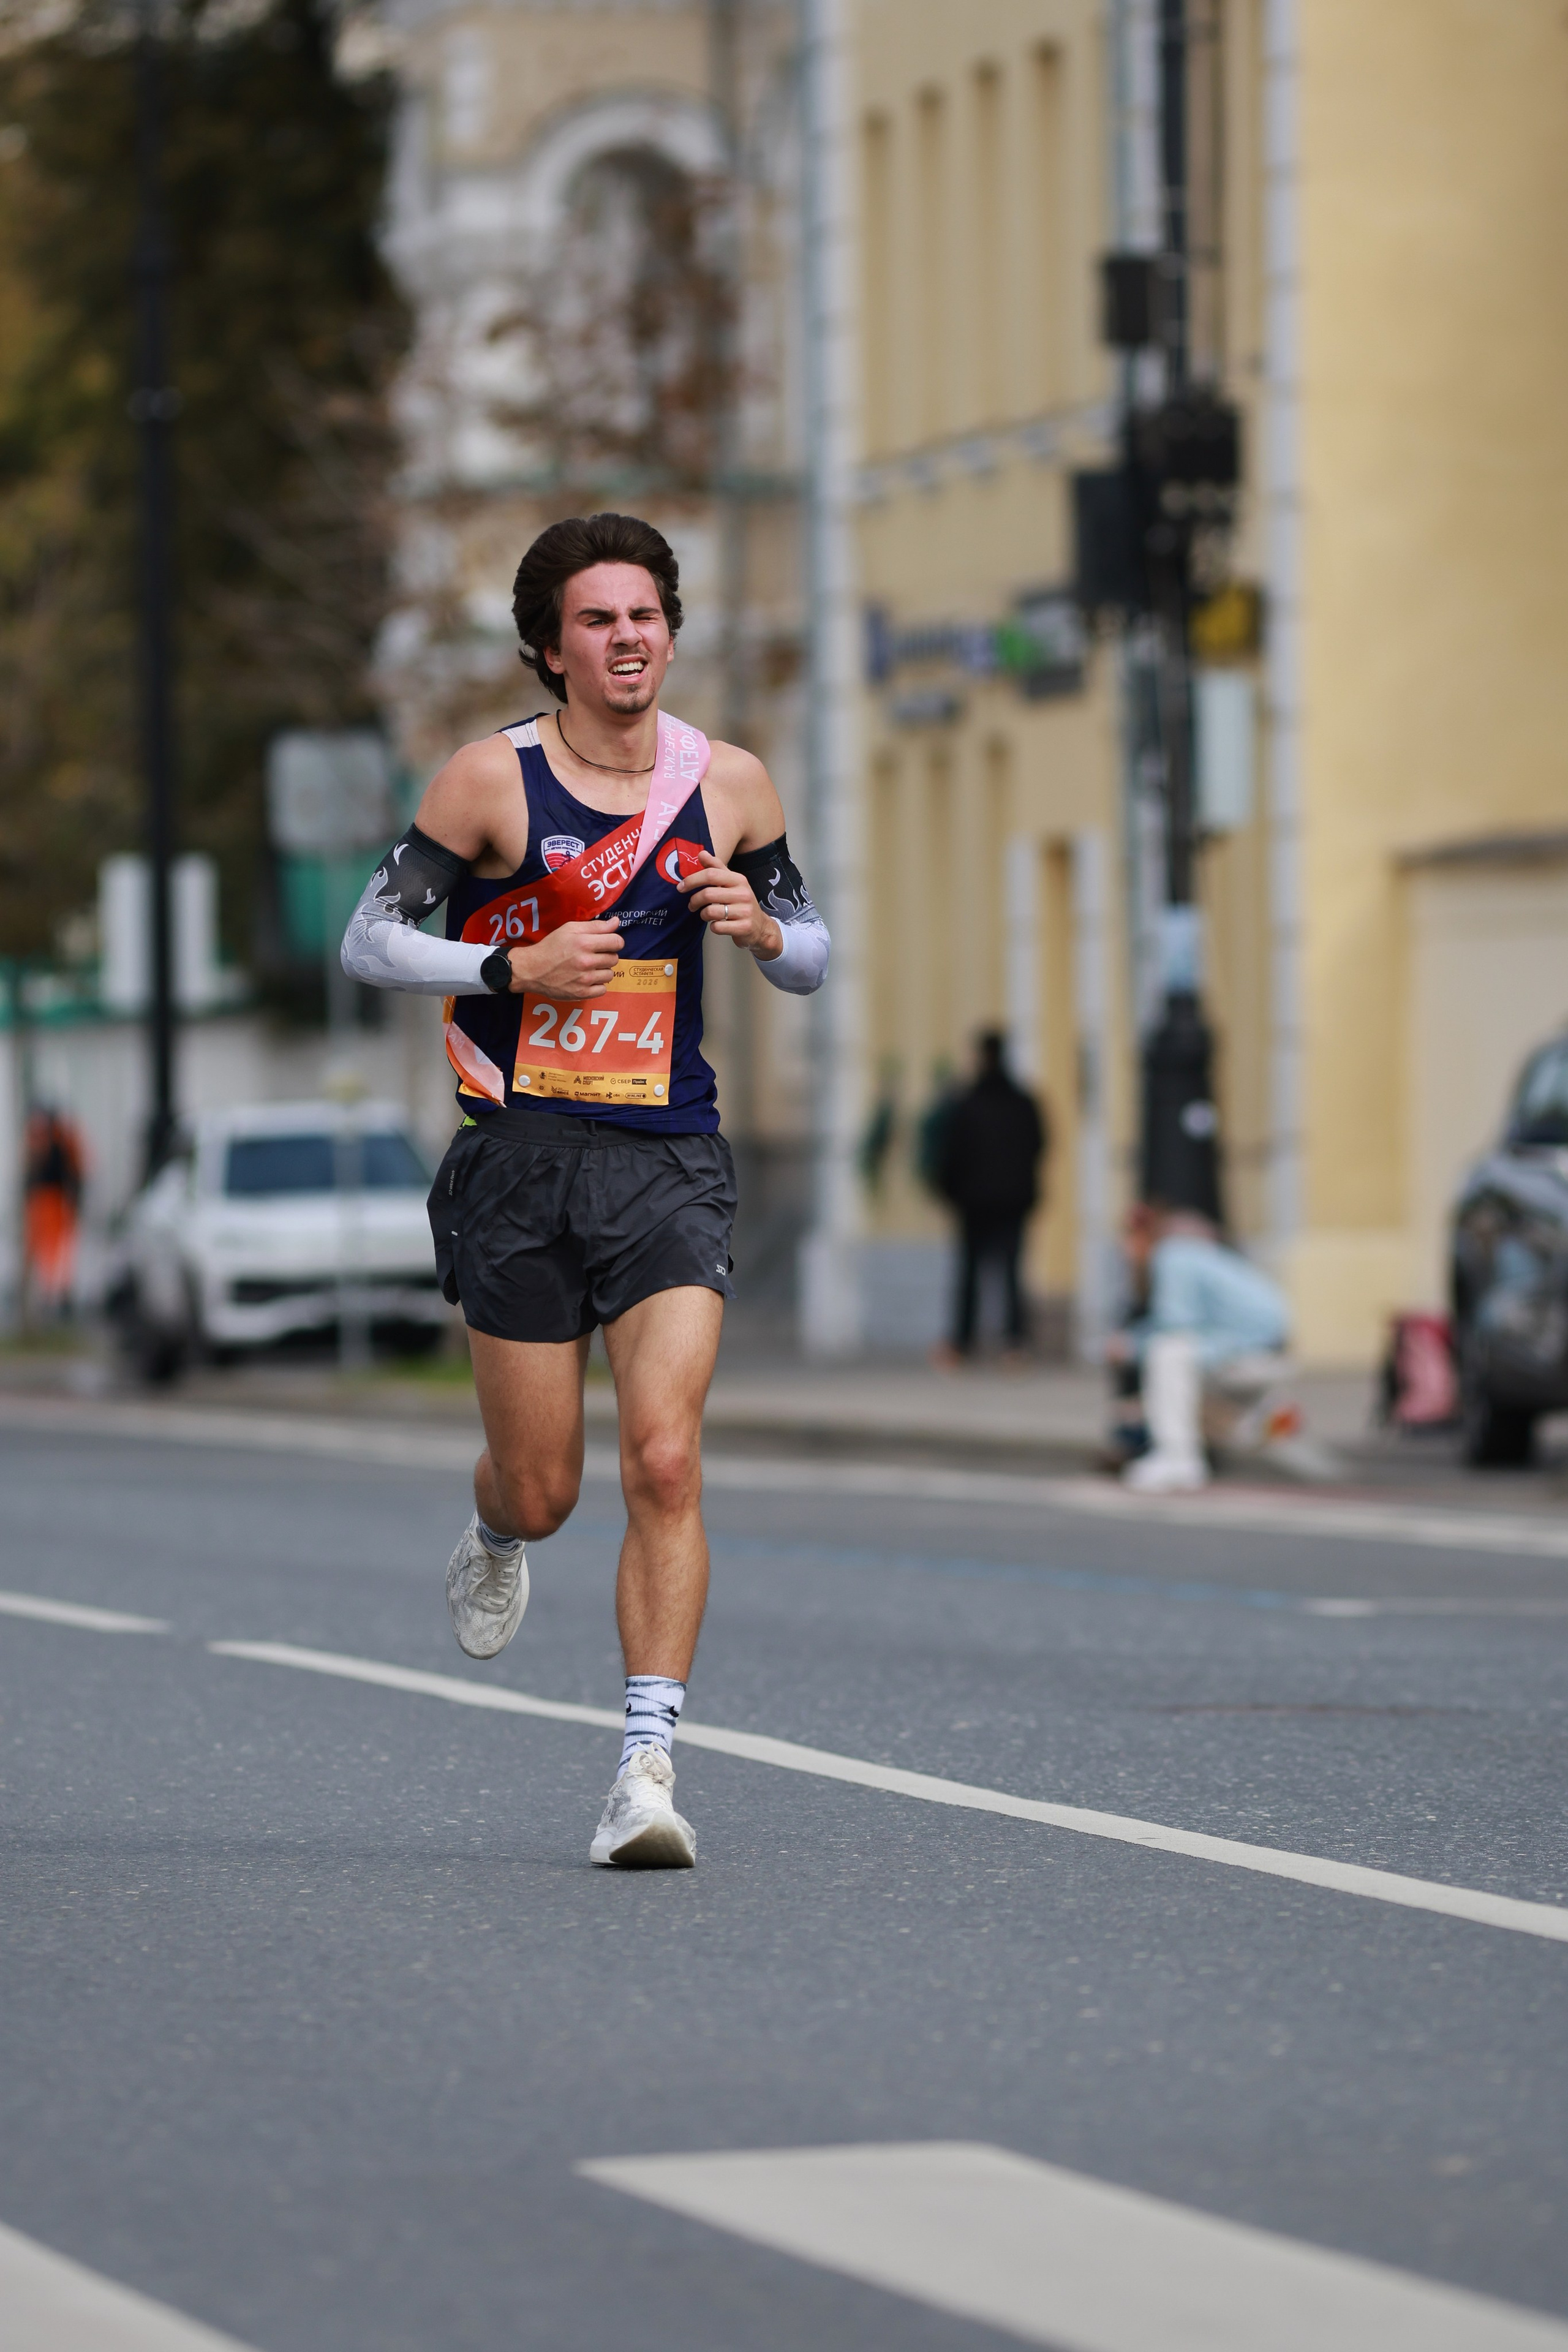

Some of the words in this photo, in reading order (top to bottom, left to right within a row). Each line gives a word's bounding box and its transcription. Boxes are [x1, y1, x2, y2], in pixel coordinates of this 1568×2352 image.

[547, 840, 579, 848] ЭВЕРЕСТ
[581, 826, 642, 879] СТУДЕНЧ
[588, 853, 636, 902] ЭСТА
[489, 897, 540, 946] 267
[529, 1003, 664, 1054] 267-4
